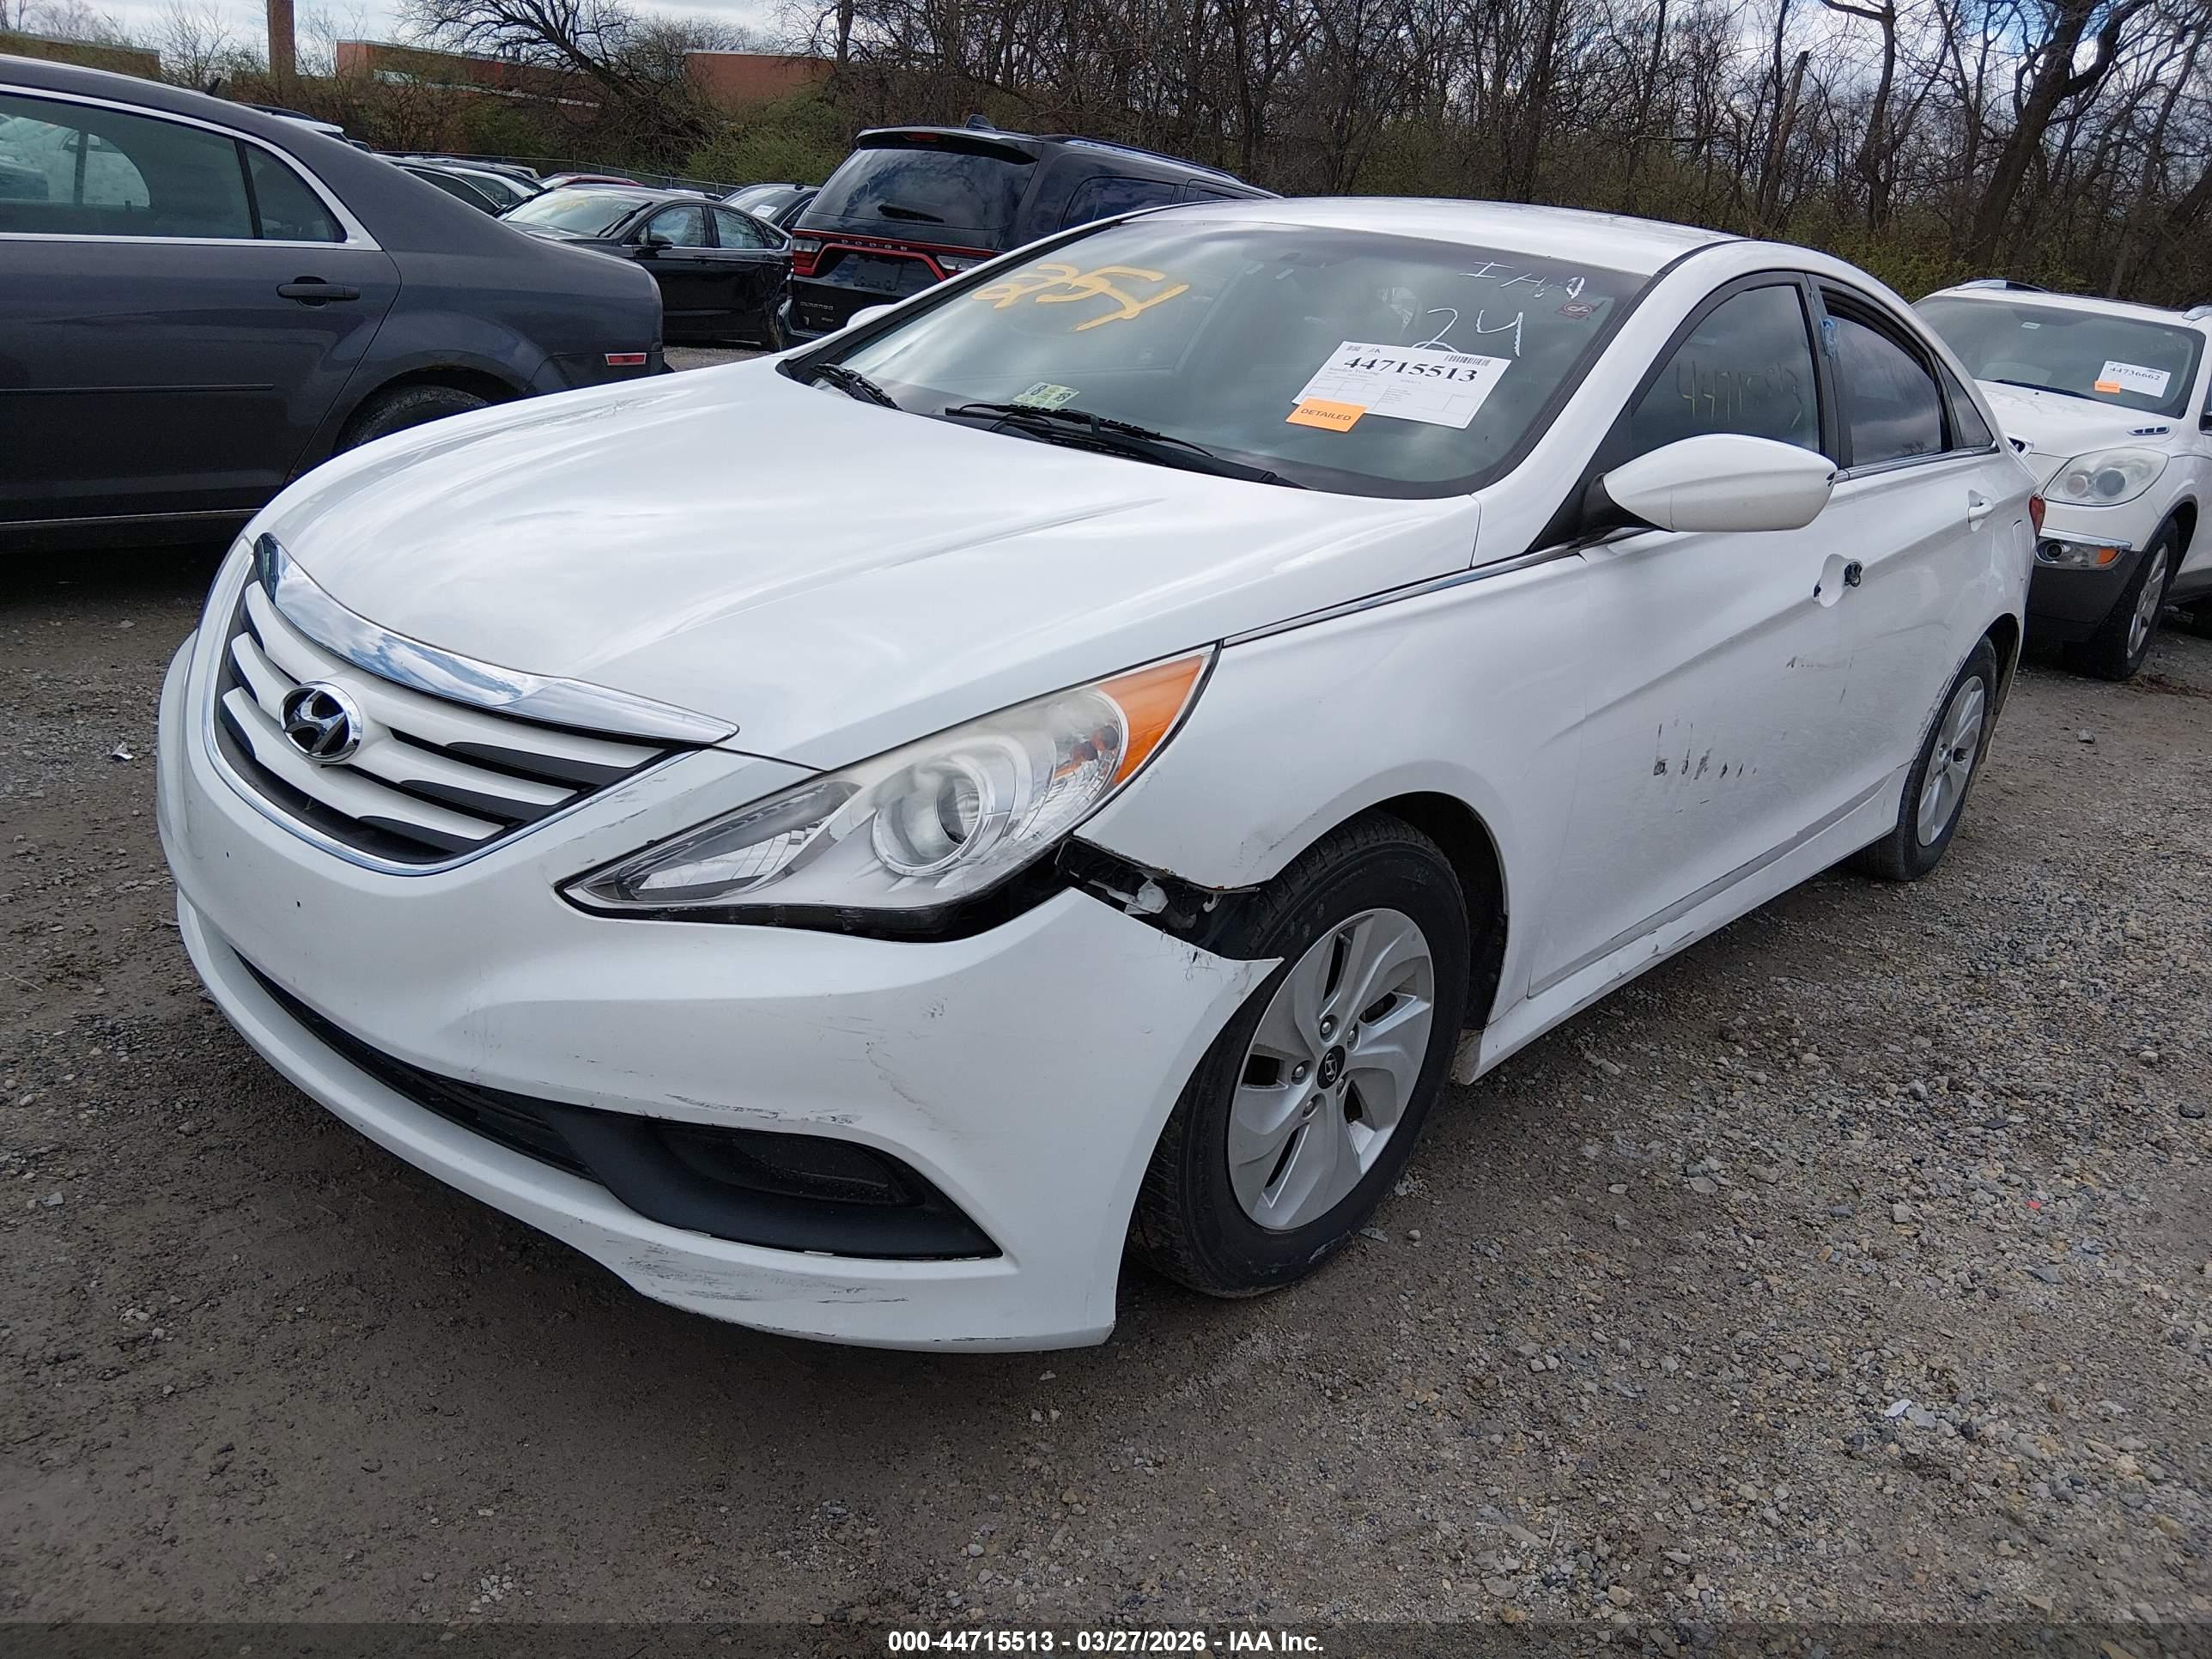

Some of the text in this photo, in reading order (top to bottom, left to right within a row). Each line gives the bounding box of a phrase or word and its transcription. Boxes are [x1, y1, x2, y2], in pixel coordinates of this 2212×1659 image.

[841, 240, 908, 251] DODGE
[1343, 356, 1477, 382] 44715513
[1300, 408, 1352, 421] DETAILED
